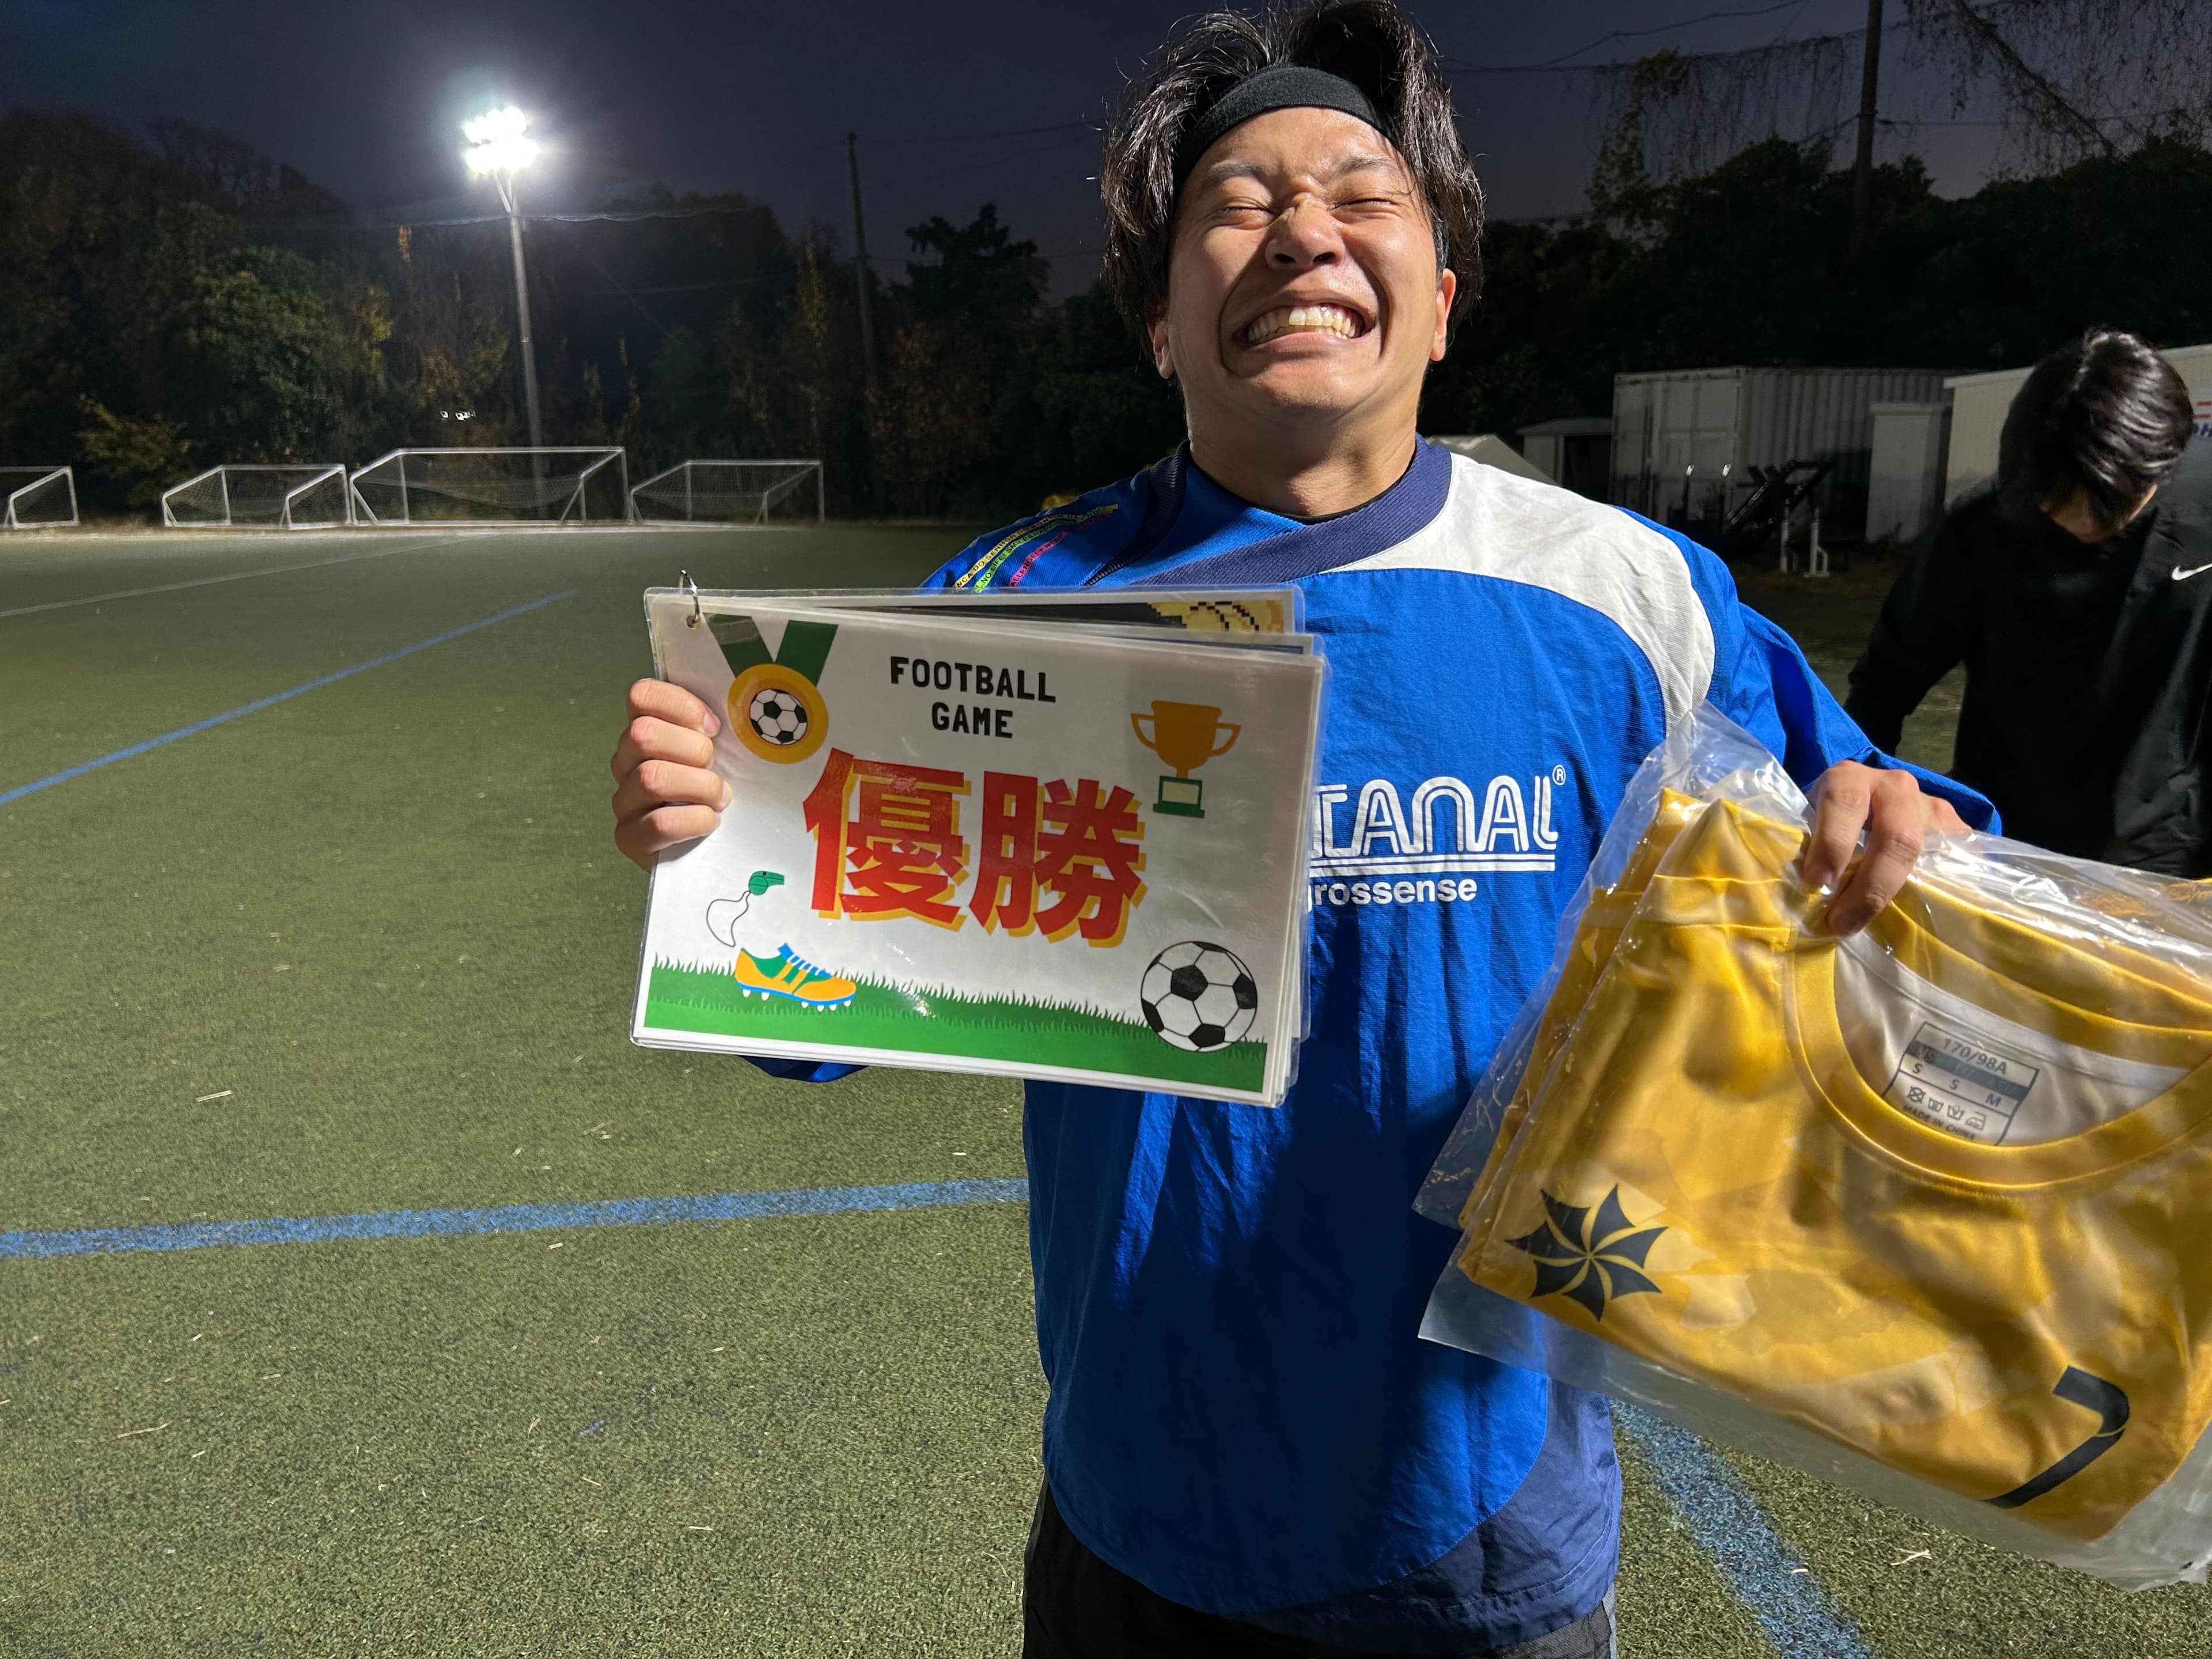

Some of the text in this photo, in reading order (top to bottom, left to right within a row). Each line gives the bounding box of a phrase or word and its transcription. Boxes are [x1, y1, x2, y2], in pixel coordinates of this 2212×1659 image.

[973, 560, 985, 572] DO
[890, 656, 1056, 703] FOOTBALL
[931, 702, 1013, 738] GAME
[802, 747, 1147, 948] 優勝
[1942, 1037, 2006, 1075] 170/98A
[1912, 1063, 2002, 1107] S S M
[1903, 1104, 1975, 1141] MADE IN CHINA
